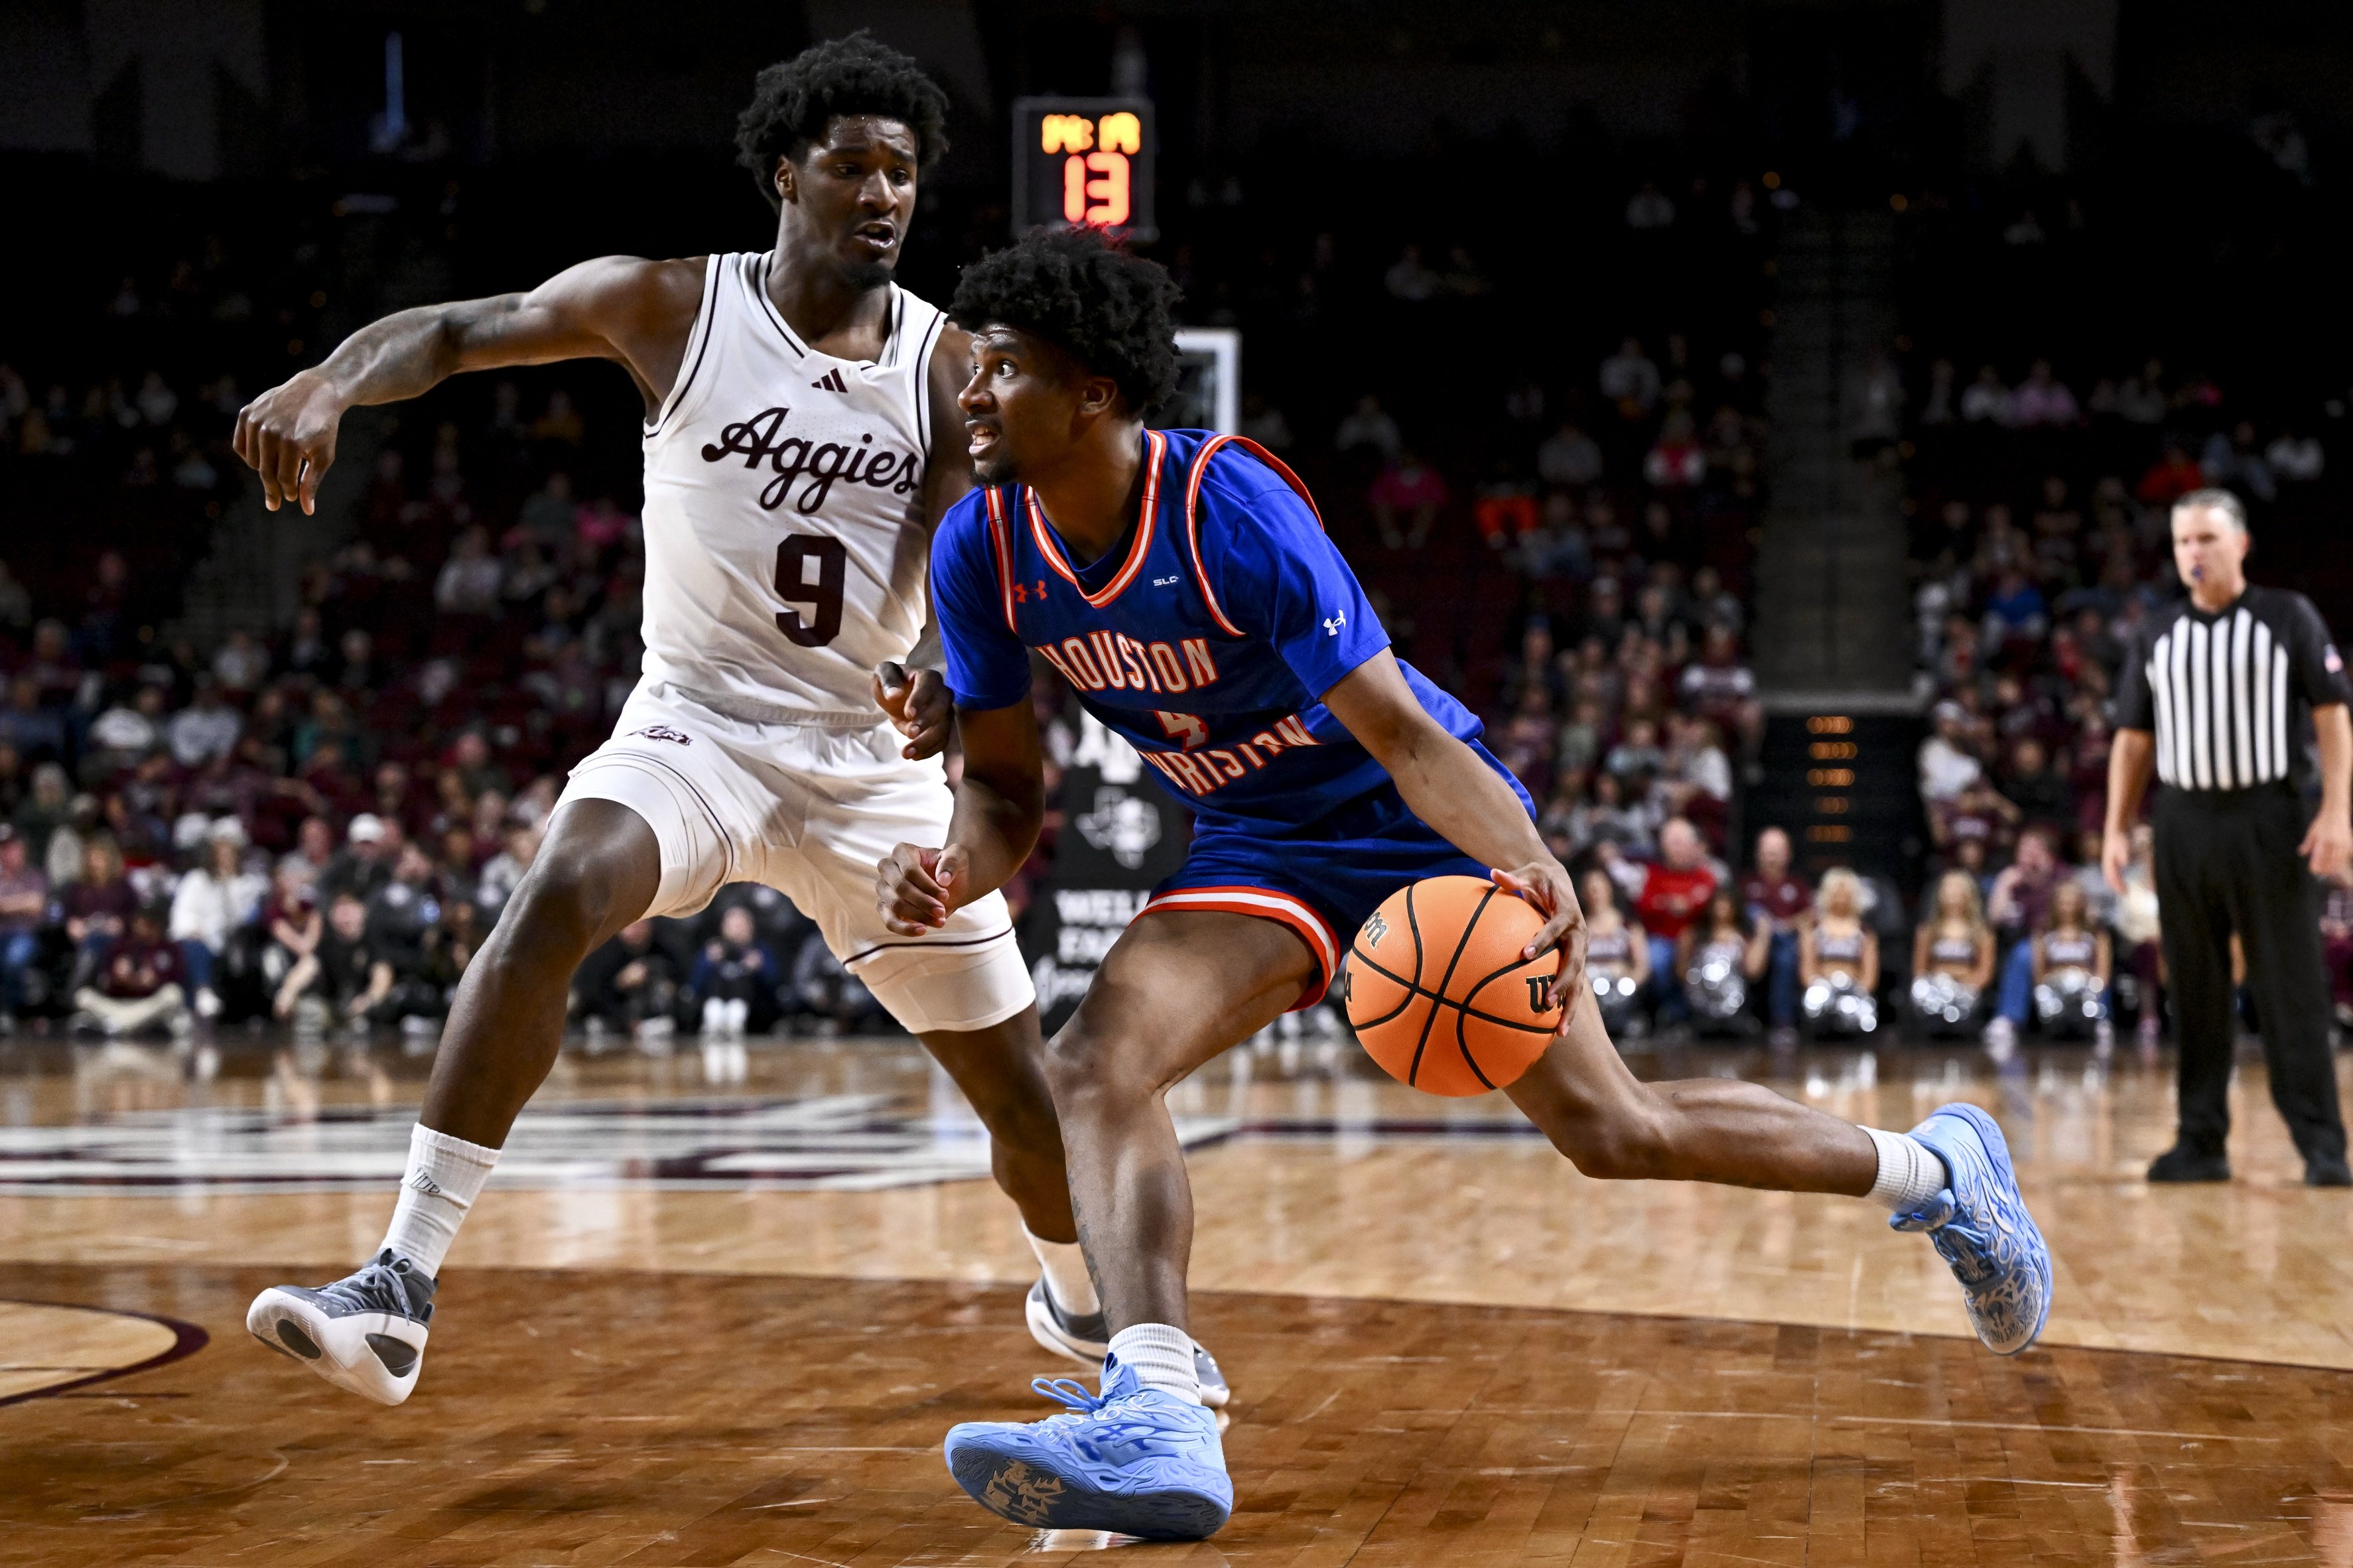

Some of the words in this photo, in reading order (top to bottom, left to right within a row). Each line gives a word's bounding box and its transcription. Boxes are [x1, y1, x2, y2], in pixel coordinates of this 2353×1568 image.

[1064, 152, 1130, 226] 13
[701, 407, 919, 514] Aggies
[774, 533, 846, 647] 9
[1153, 575, 1179, 586] SLC
[1035, 629, 1219, 694] HOUSTON
